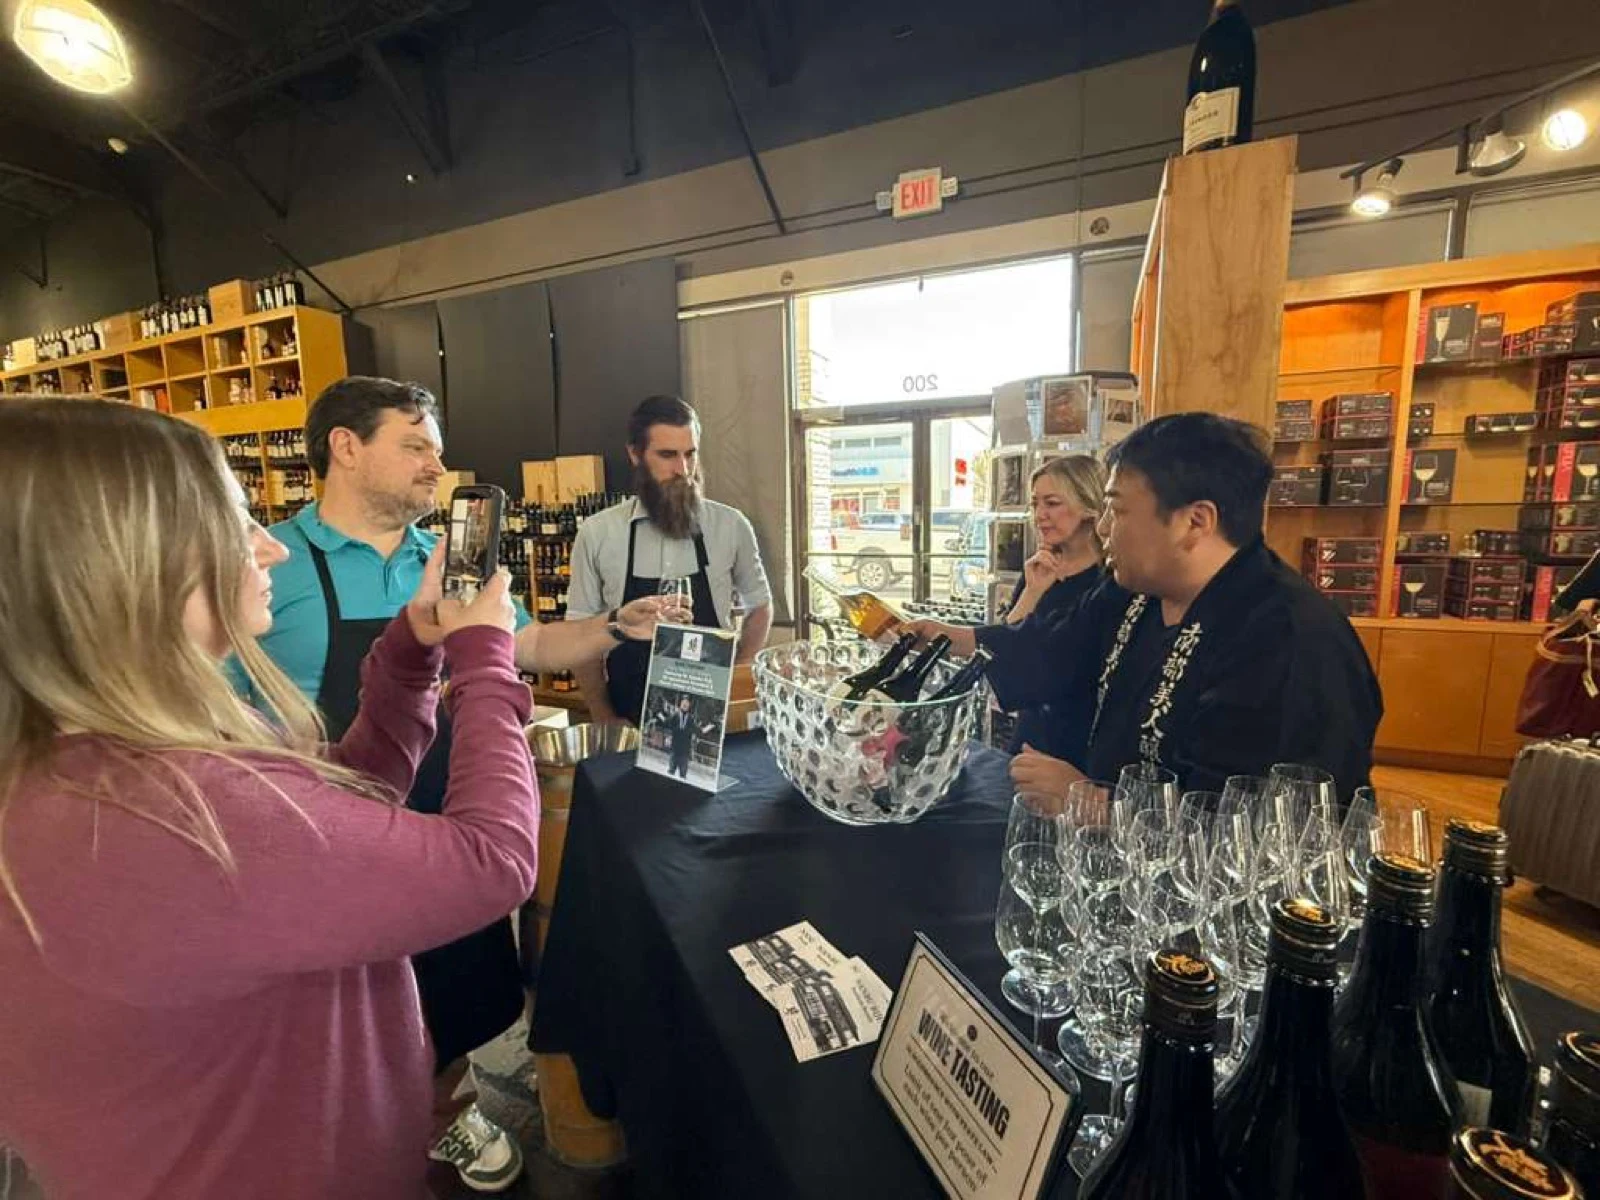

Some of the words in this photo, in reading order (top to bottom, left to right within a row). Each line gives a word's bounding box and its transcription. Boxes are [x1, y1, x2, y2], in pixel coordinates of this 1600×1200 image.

[900, 176, 936, 212] EXIT
[918, 1009, 952, 1066] WINE
[950, 1049, 1011, 1140] TASTING
